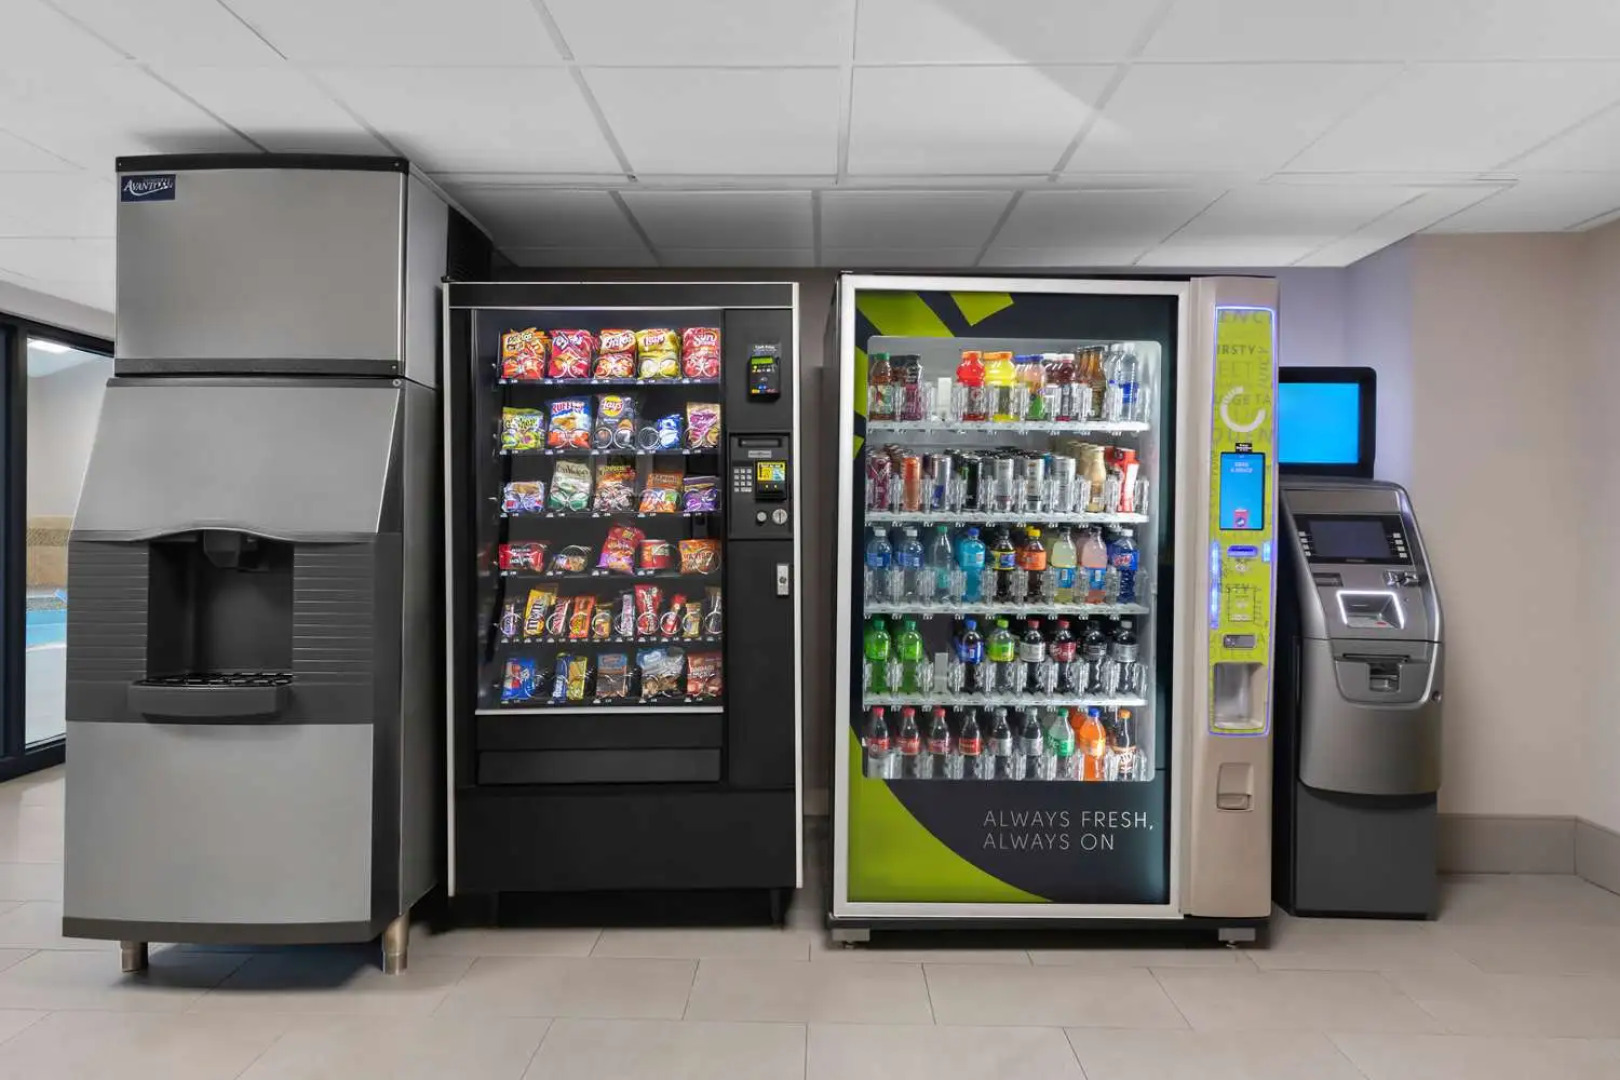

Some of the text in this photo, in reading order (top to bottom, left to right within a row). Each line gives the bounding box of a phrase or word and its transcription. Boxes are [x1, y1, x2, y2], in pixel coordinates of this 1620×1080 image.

[983, 810, 1154, 830] ALWAYS FRESH,
[983, 832, 1115, 850] ALWAYS ON
